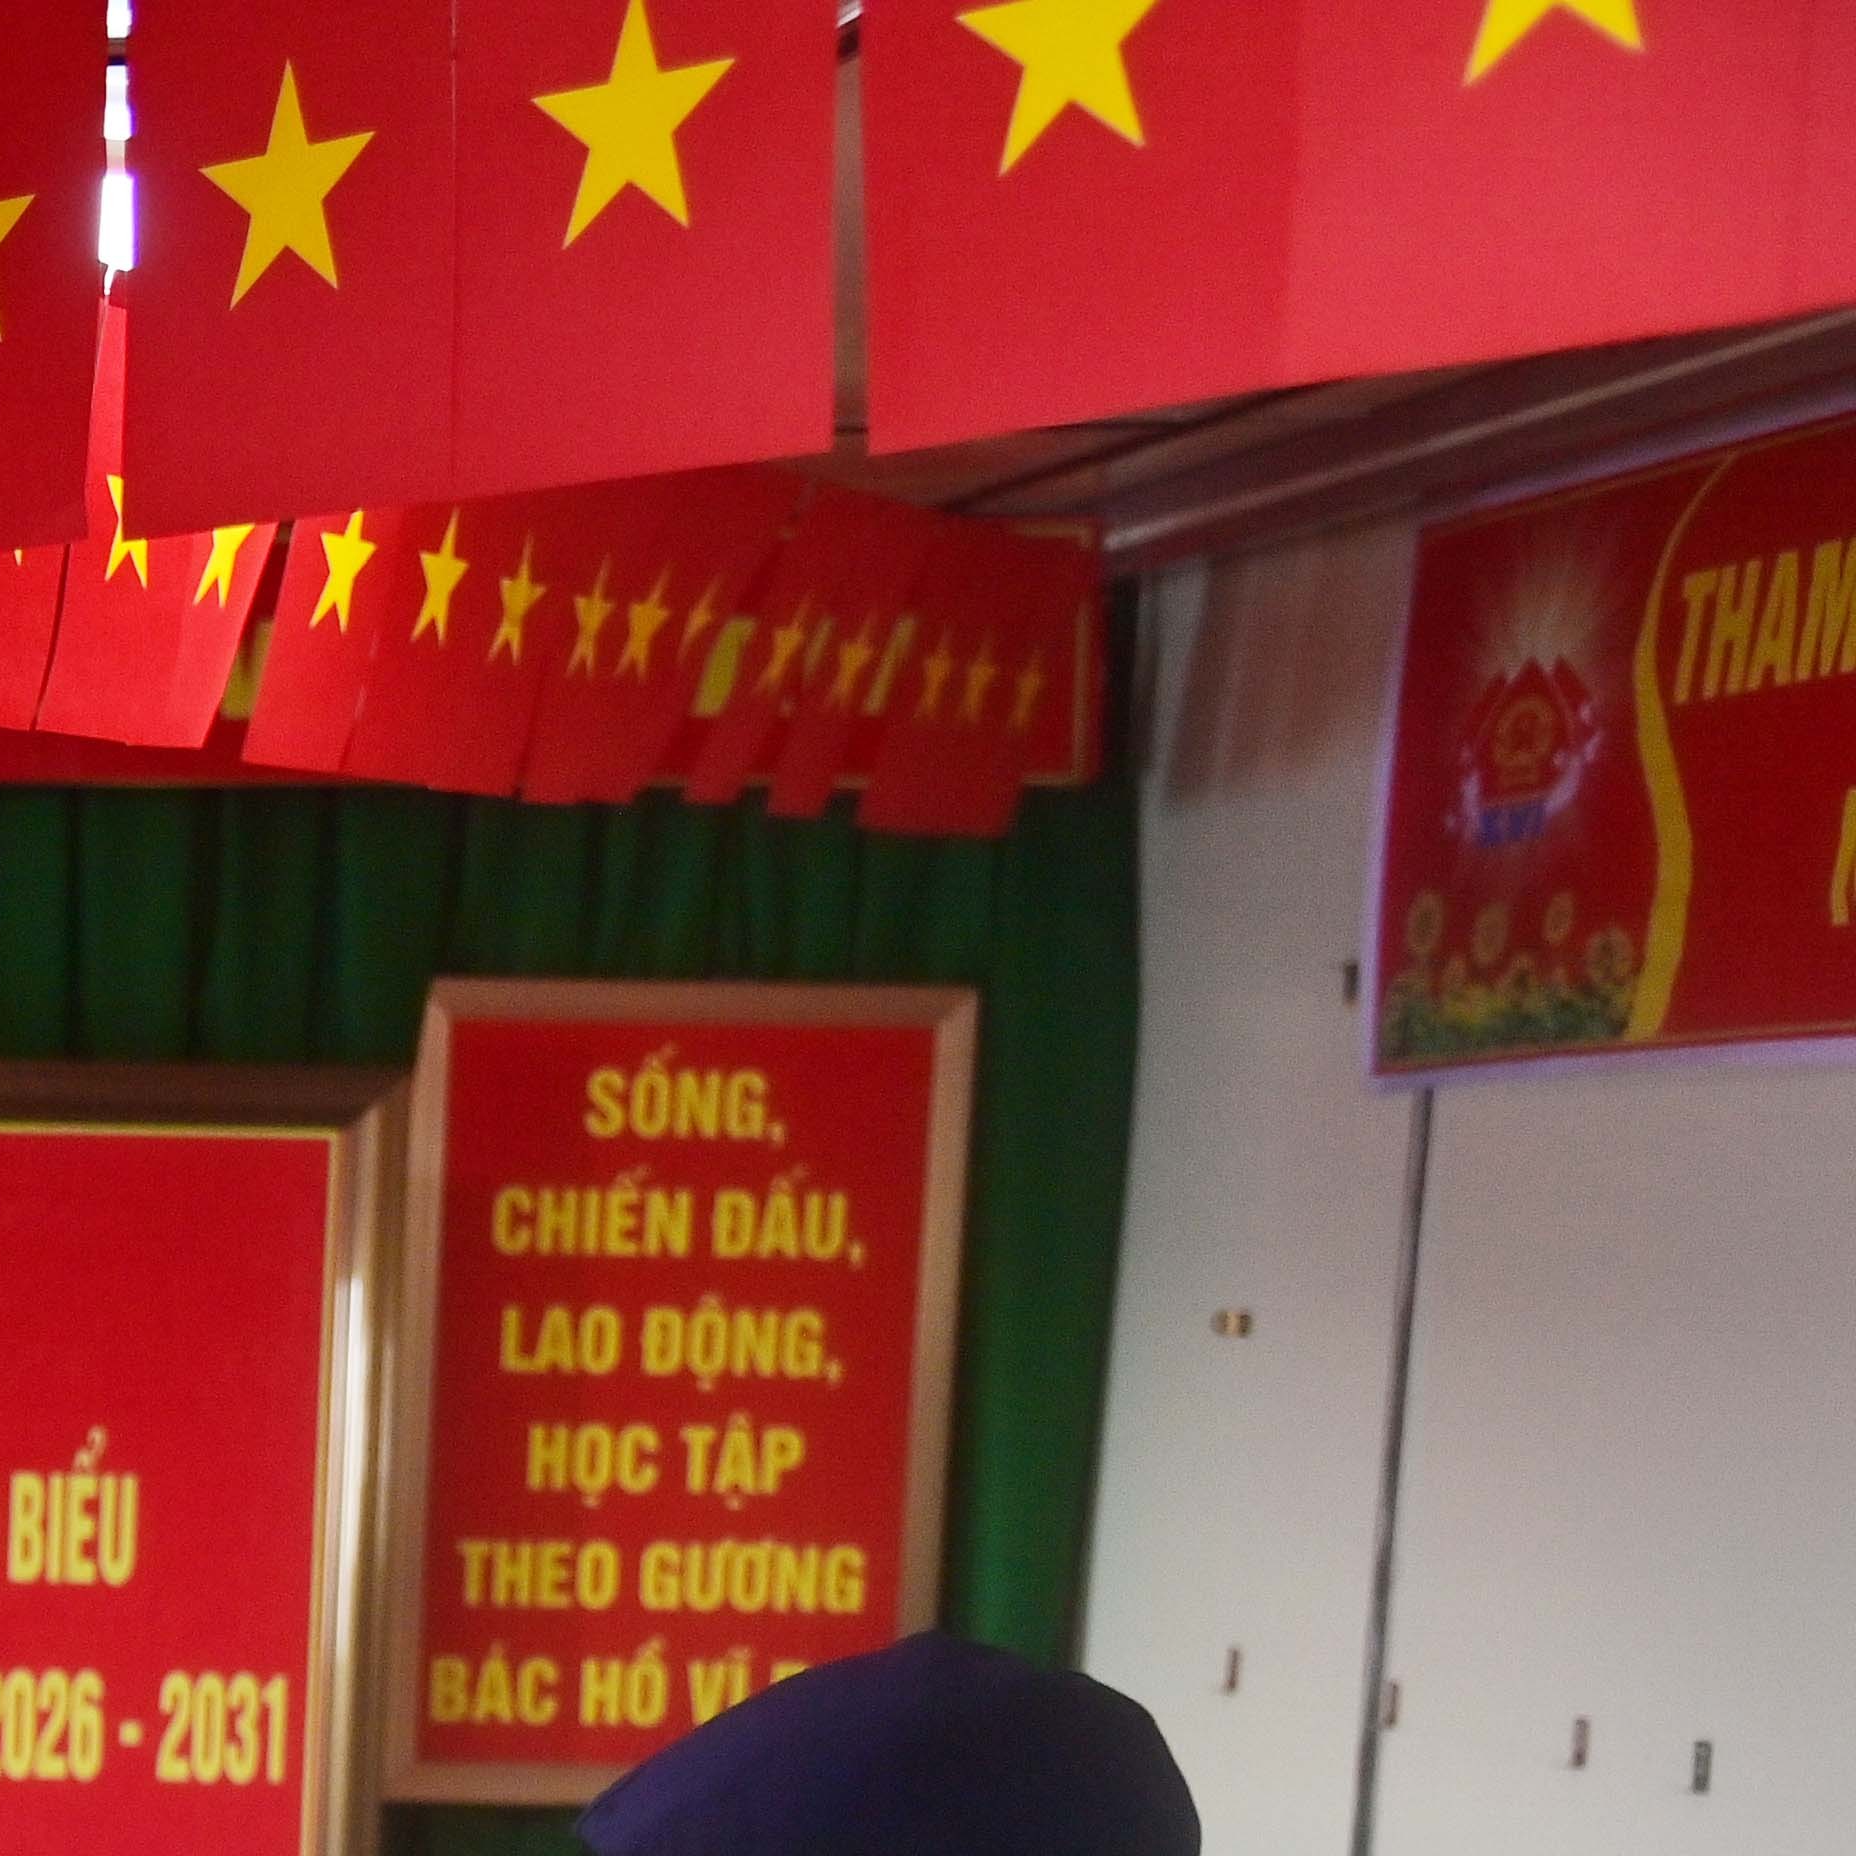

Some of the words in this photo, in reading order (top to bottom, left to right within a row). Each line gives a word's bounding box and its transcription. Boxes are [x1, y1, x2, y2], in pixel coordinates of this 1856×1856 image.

[584, 1041, 785, 1142] SỐNG,
[492, 1165, 696, 1258] CHIẾN
[710, 1165, 868, 1266] ĐẤU,
[500, 1305, 625, 1376] LAO
[640, 1296, 844, 1388] ĐỘNG,
[7, 1425, 140, 1587] BIỂU
[526, 1422, 664, 1509] HỌC
[682, 1412, 806, 1511] TẬP
[458, 1540, 624, 1611] THEO
[639, 1539, 867, 1614] GƯƠNG
[117, 1717, 146, 1749] -
[156, 1670, 290, 1786] 2031
[428, 1638, 562, 1726] BÁC
